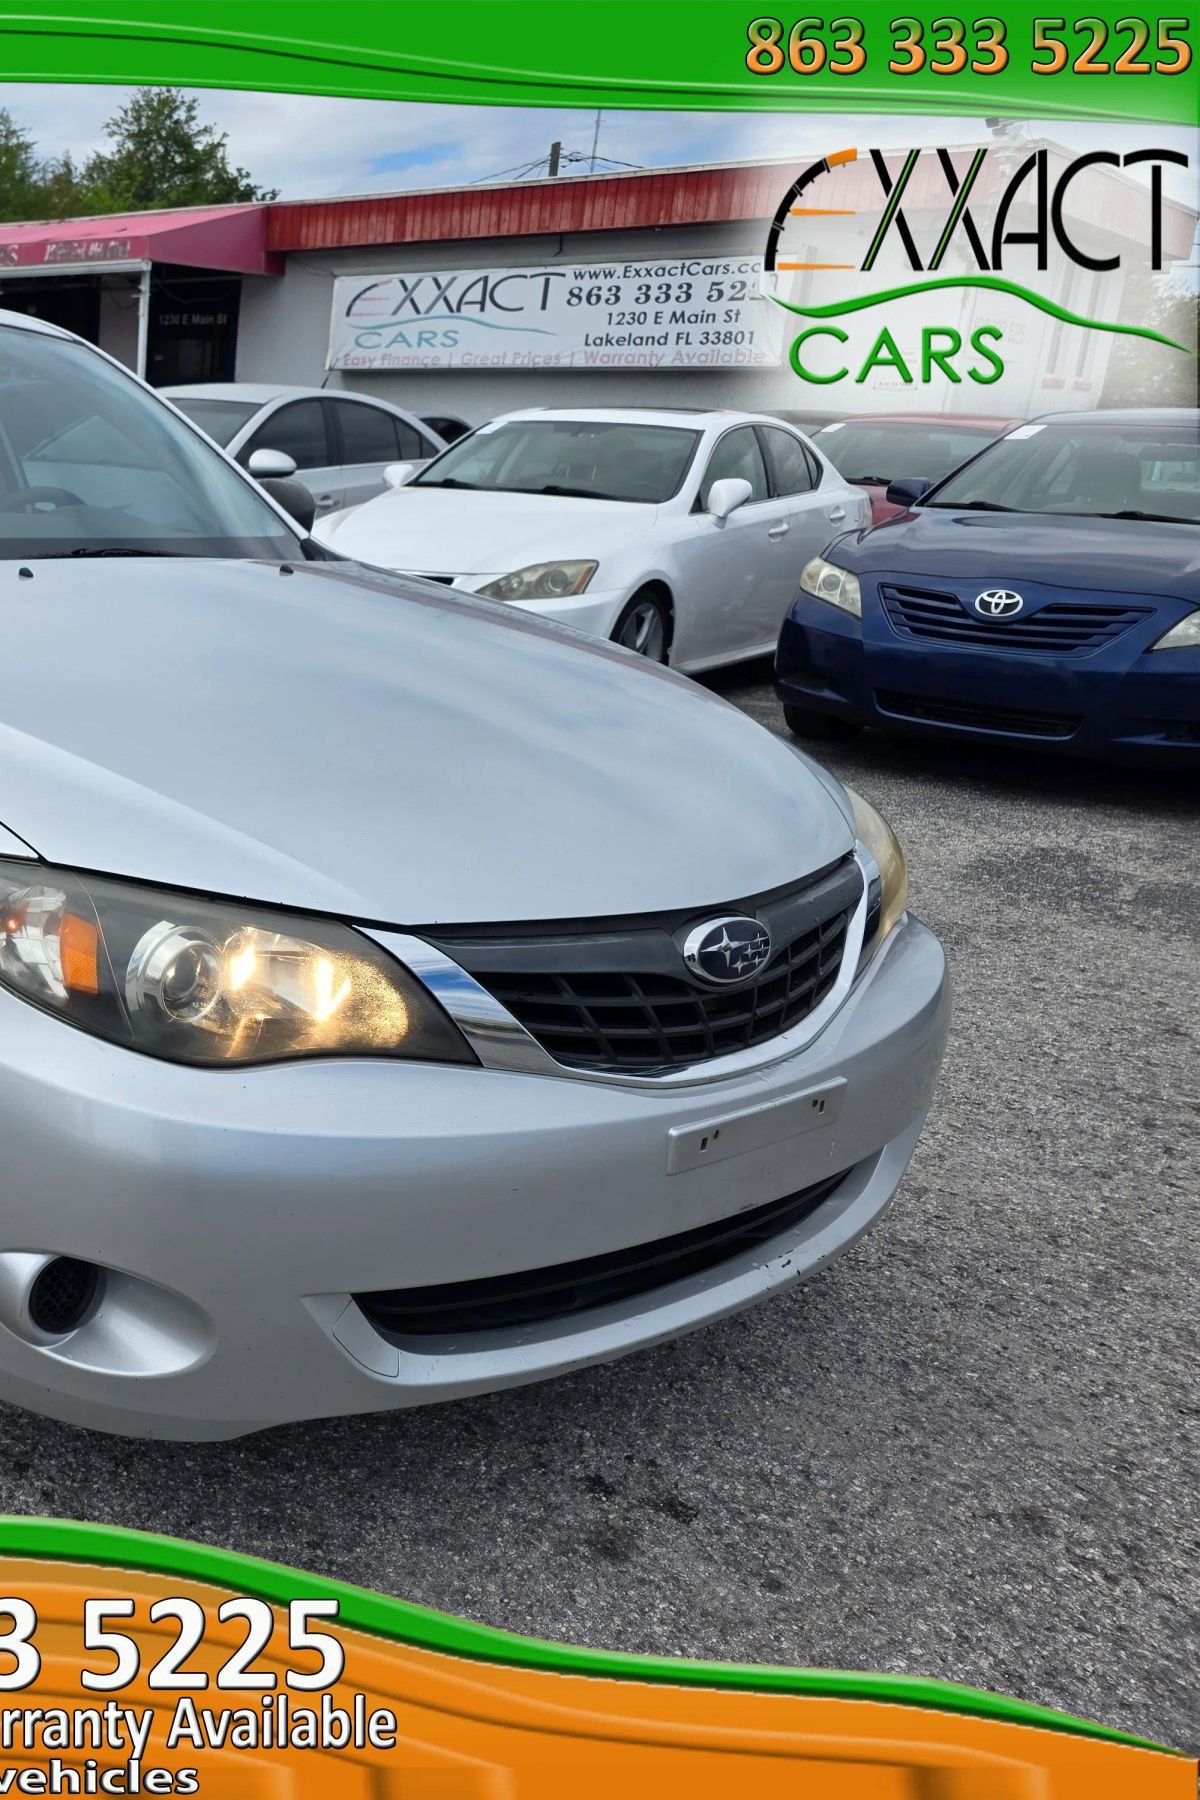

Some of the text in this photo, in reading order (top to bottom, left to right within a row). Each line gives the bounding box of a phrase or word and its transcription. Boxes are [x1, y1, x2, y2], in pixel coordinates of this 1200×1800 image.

[573, 261, 761, 280] www.ExxactCars.co
[345, 272, 566, 317] EXXACT
[566, 285, 621, 307] 863
[634, 282, 693, 304] 333
[182, 314, 189, 325] E
[606, 308, 741, 326] 1230 E Main St
[354, 330, 459, 349] CARS
[584, 331, 755, 347] Lakeland FL 33801
[343, 349, 766, 368] Easy Finance Great Prices Warranty Available
